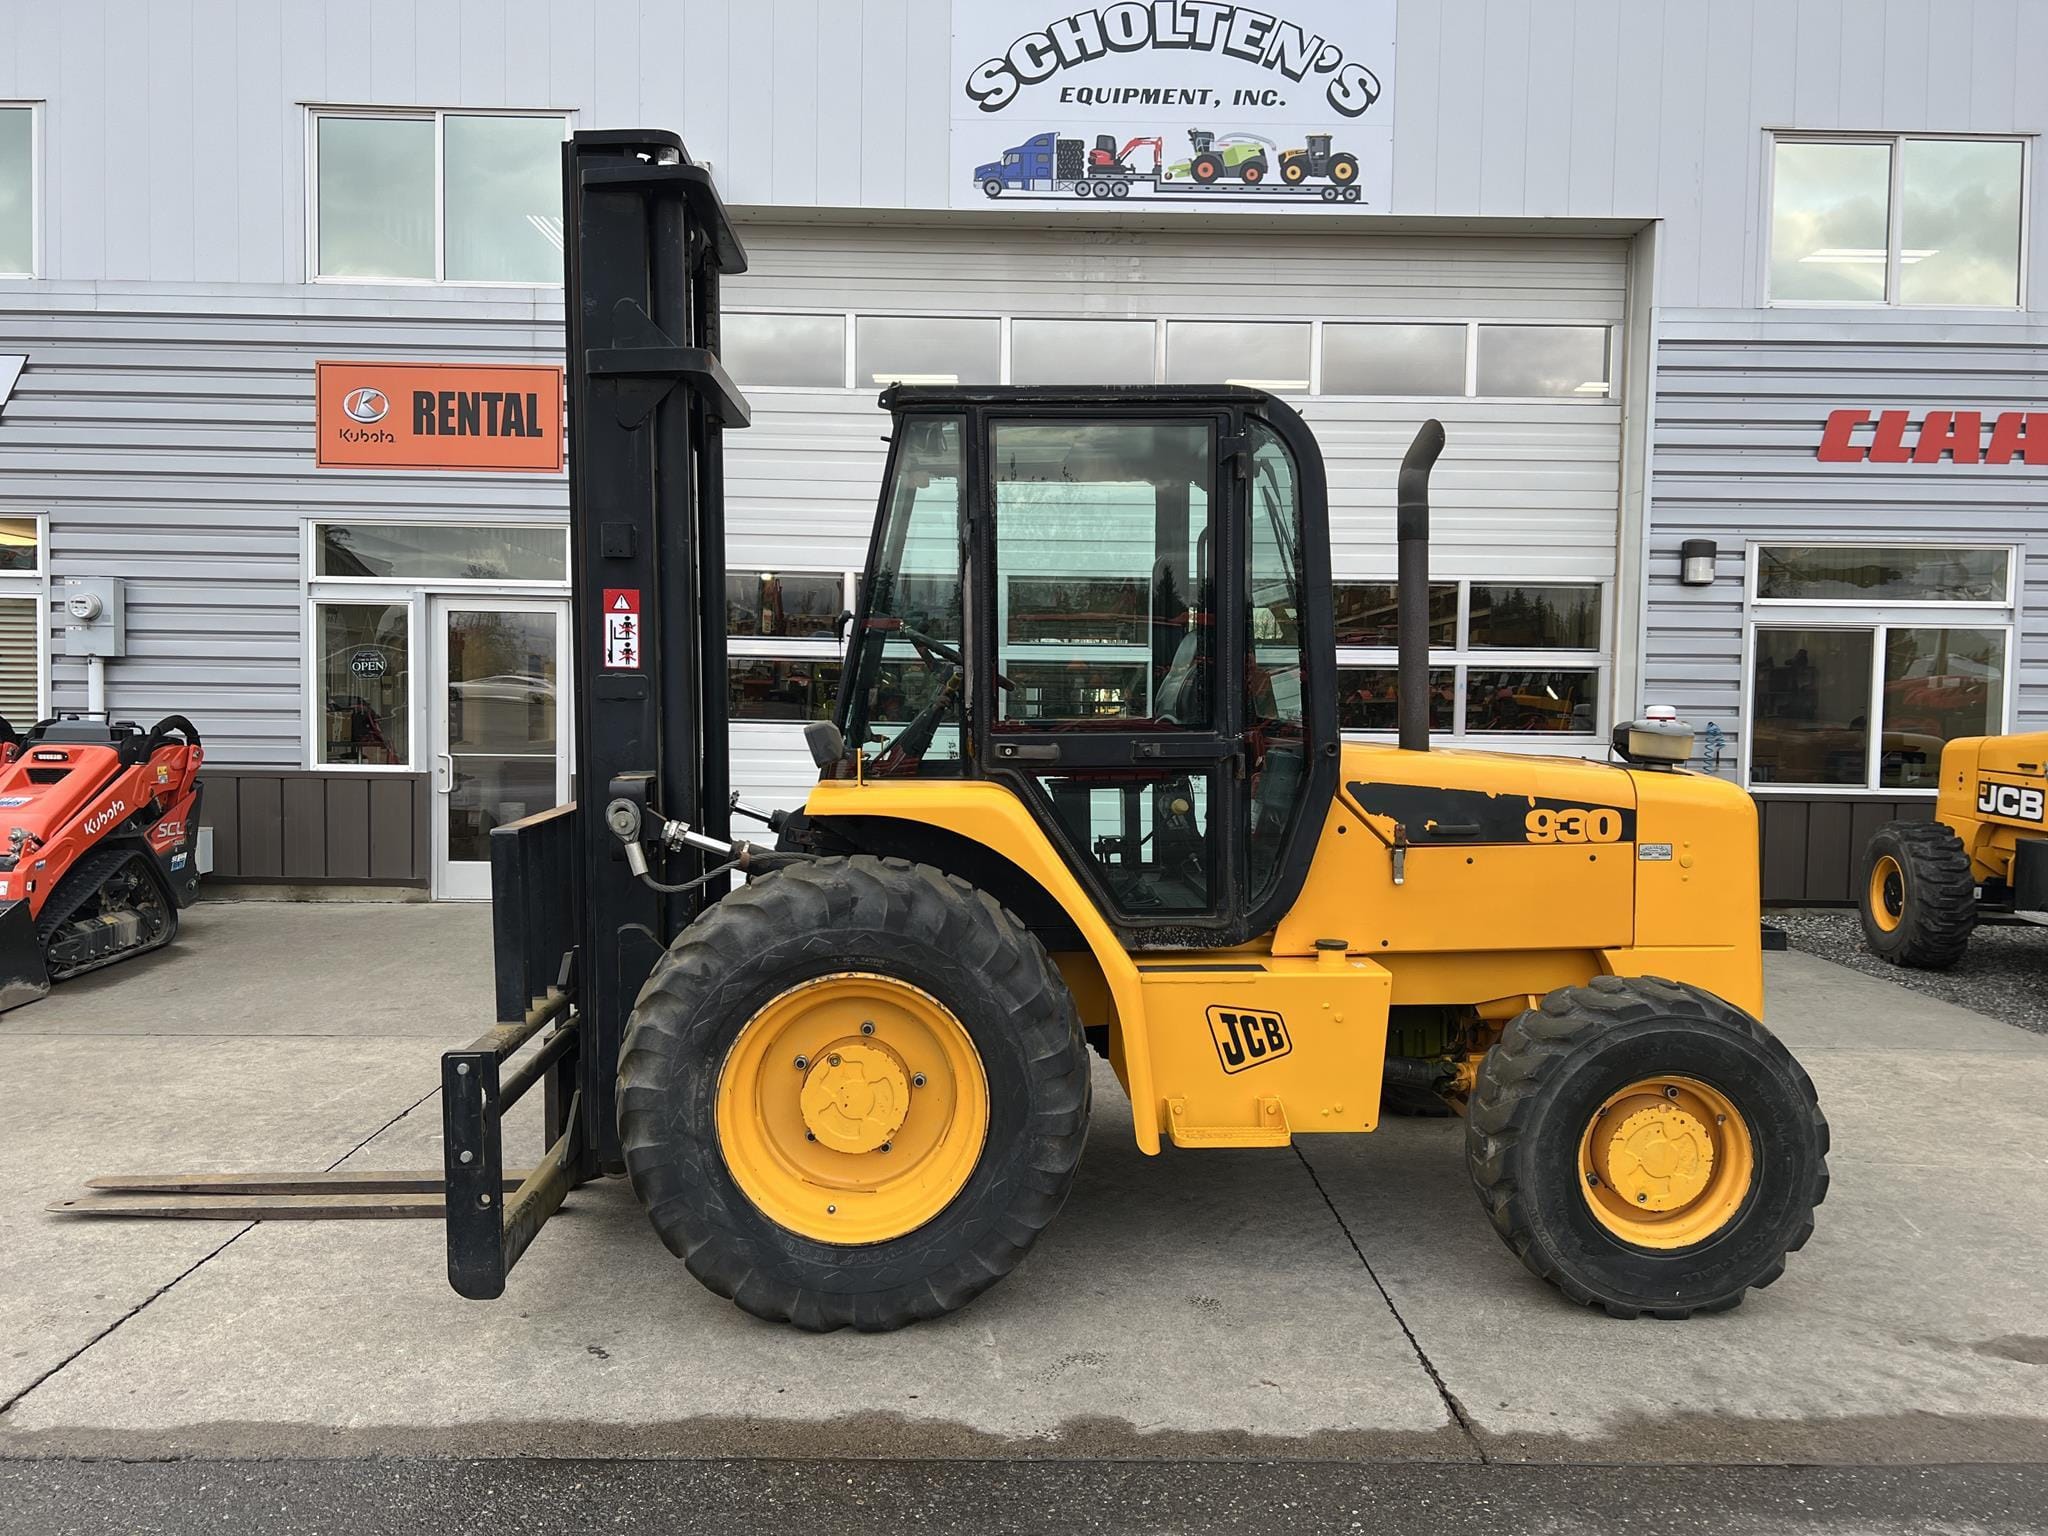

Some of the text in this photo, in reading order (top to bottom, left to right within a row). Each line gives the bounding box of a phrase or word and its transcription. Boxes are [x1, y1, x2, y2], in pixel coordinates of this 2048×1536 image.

[965, 0, 1381, 118] SCHOLTEN'S
[1060, 87, 1287, 108] EQUIPMENT, INC.
[412, 390, 544, 438] RENTAL
[339, 428, 396, 443] Kubota
[351, 661, 385, 672] OPEN
[83, 799, 126, 835] Kubota
[1978, 784, 2044, 820] JCB
[157, 821, 185, 839] SCL
[1525, 808, 1622, 844] 930
[1219, 1012, 1286, 1067] JCB
